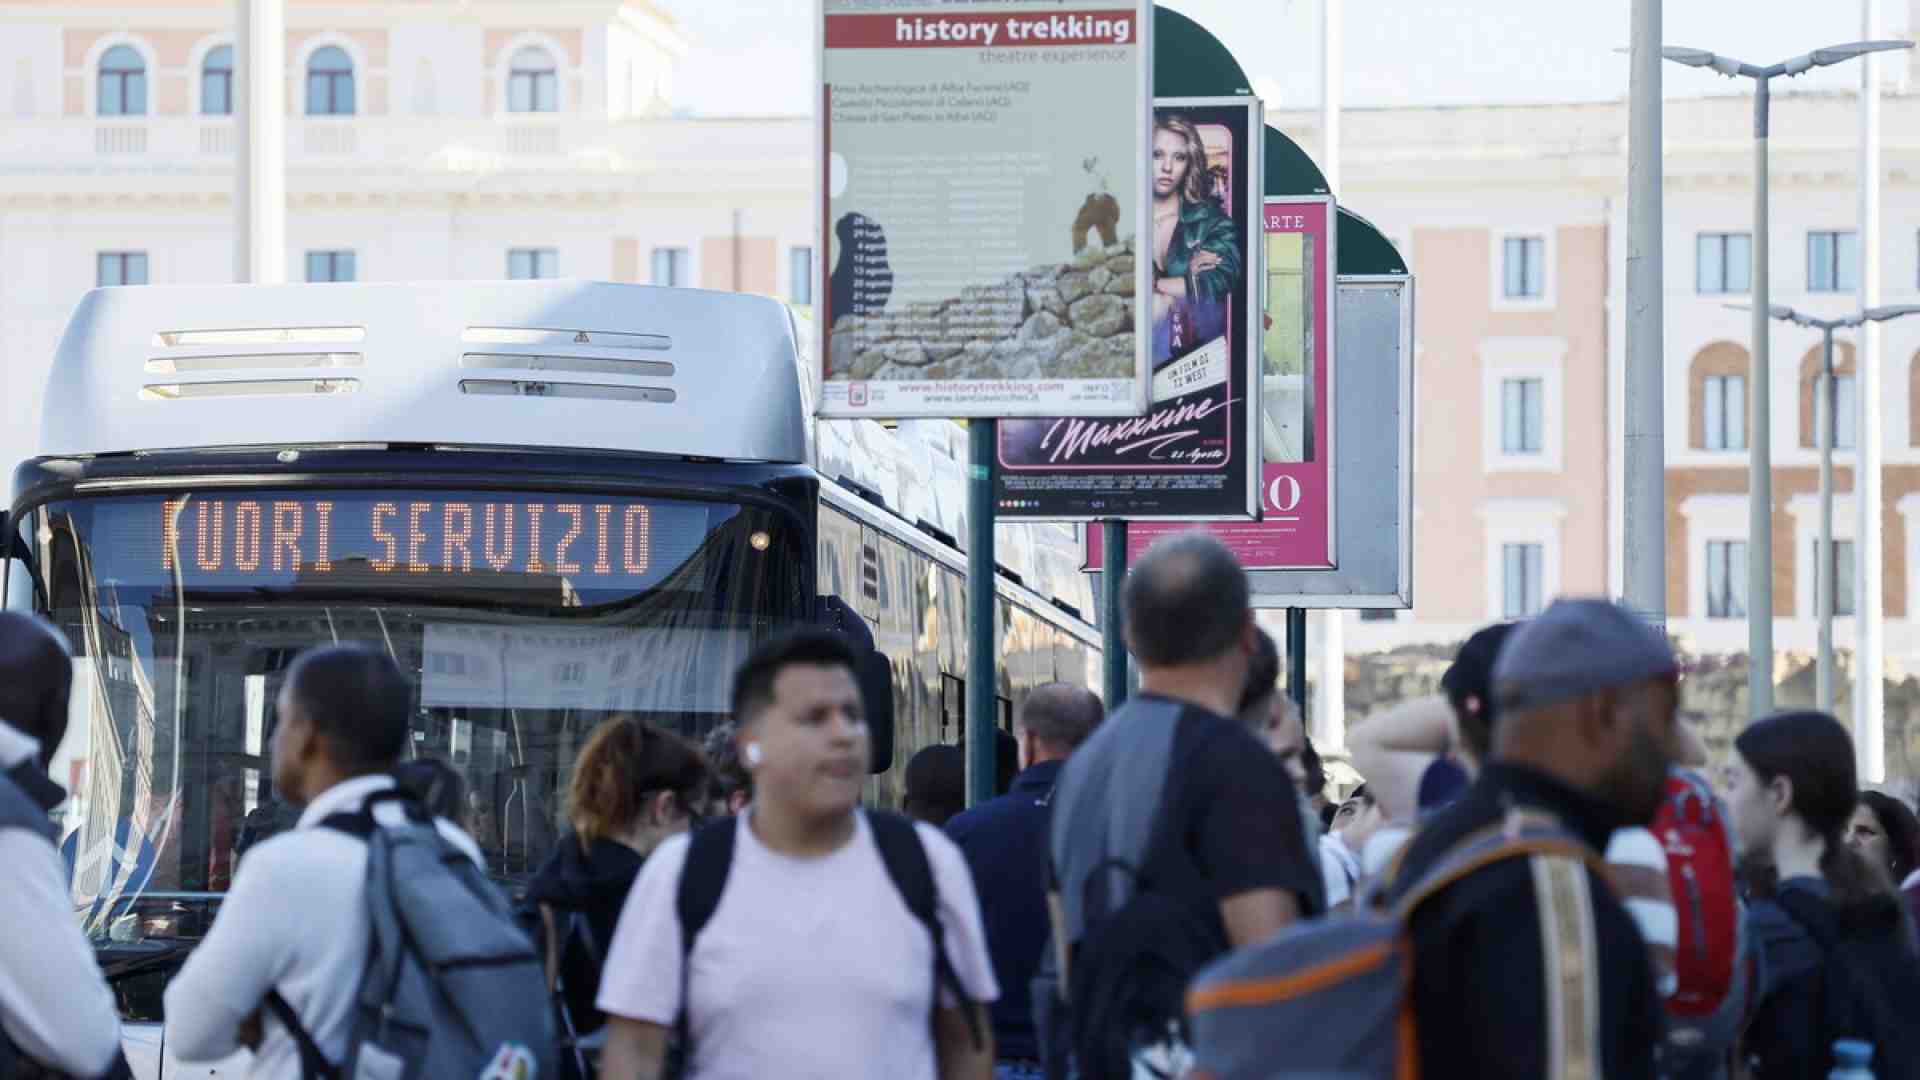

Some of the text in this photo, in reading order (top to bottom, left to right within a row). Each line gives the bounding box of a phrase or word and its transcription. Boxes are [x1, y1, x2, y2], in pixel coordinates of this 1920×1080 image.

[895, 15, 1130, 44] history trekking
[1185, 368, 1208, 385] WEST
[1263, 475, 1301, 511] O
[161, 500, 650, 574] FUORI SERVIZIO
